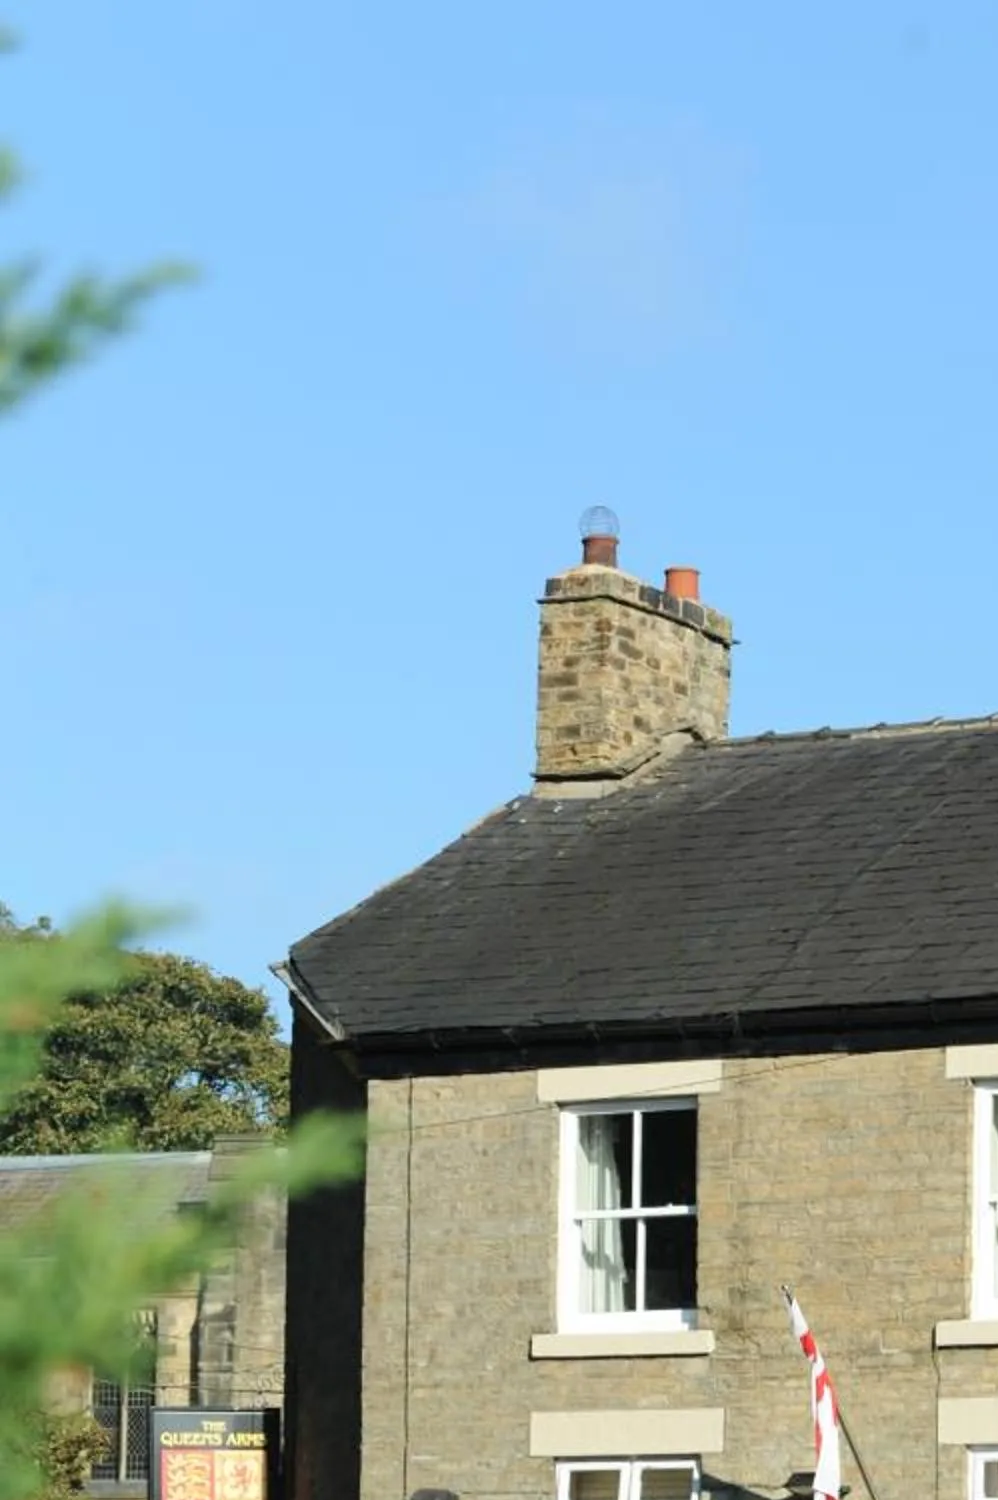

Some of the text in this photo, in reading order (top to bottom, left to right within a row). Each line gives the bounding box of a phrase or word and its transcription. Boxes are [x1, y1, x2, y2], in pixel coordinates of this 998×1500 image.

[202, 1421, 226, 1432] THE
[160, 1431, 267, 1448] QUEENS ARMS
